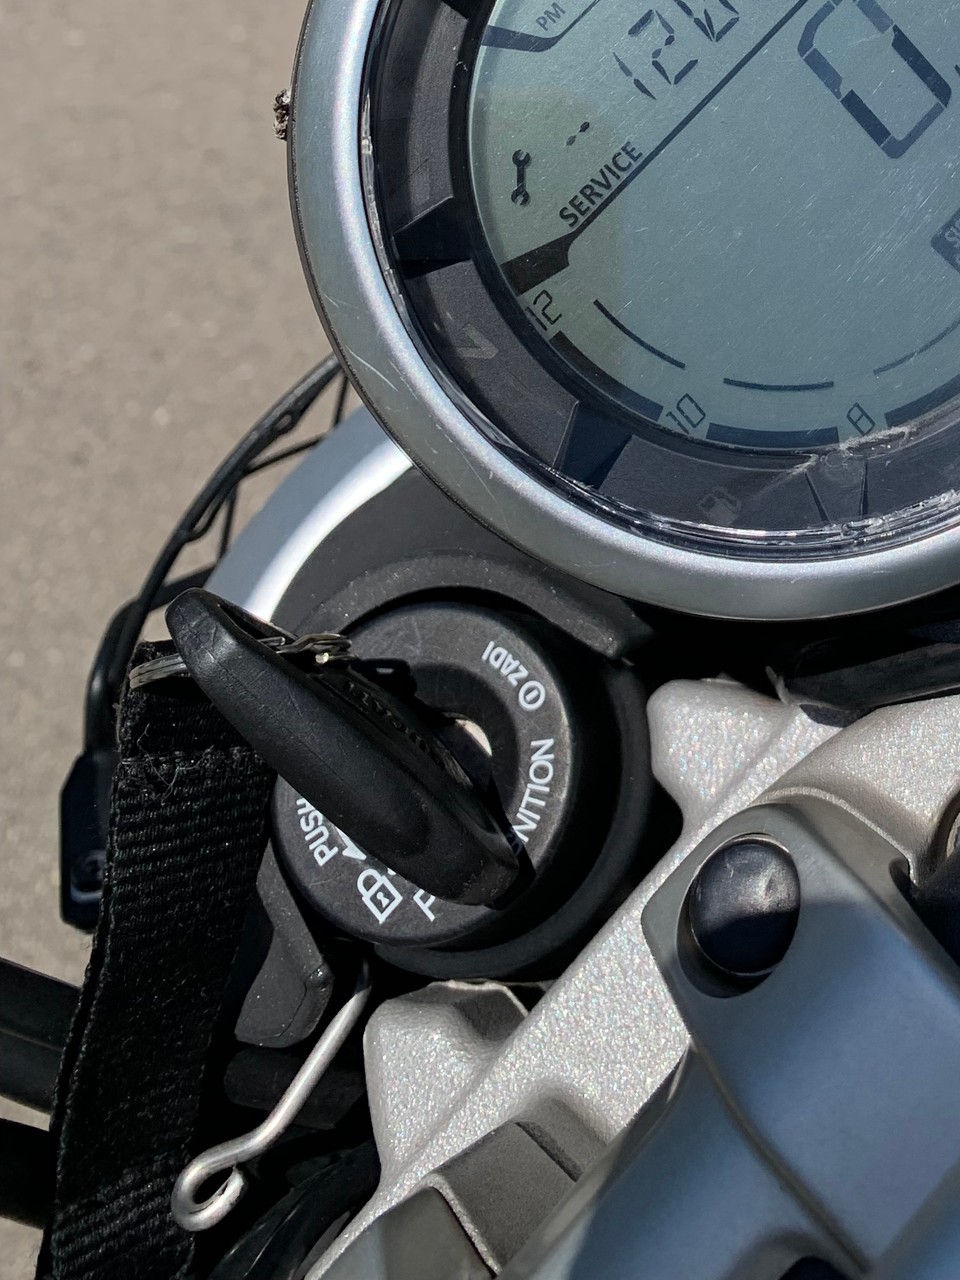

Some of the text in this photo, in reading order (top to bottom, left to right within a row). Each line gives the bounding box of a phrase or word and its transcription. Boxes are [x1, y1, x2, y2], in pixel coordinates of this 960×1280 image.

[535, 2, 566, 32] PM
[559, 141, 643, 227] SERVICE
[525, 290, 562, 331] 12
[666, 393, 706, 434] 10
[846, 402, 875, 436] 8
[482, 640, 529, 687] ZADI
[507, 738, 555, 856] NITION
